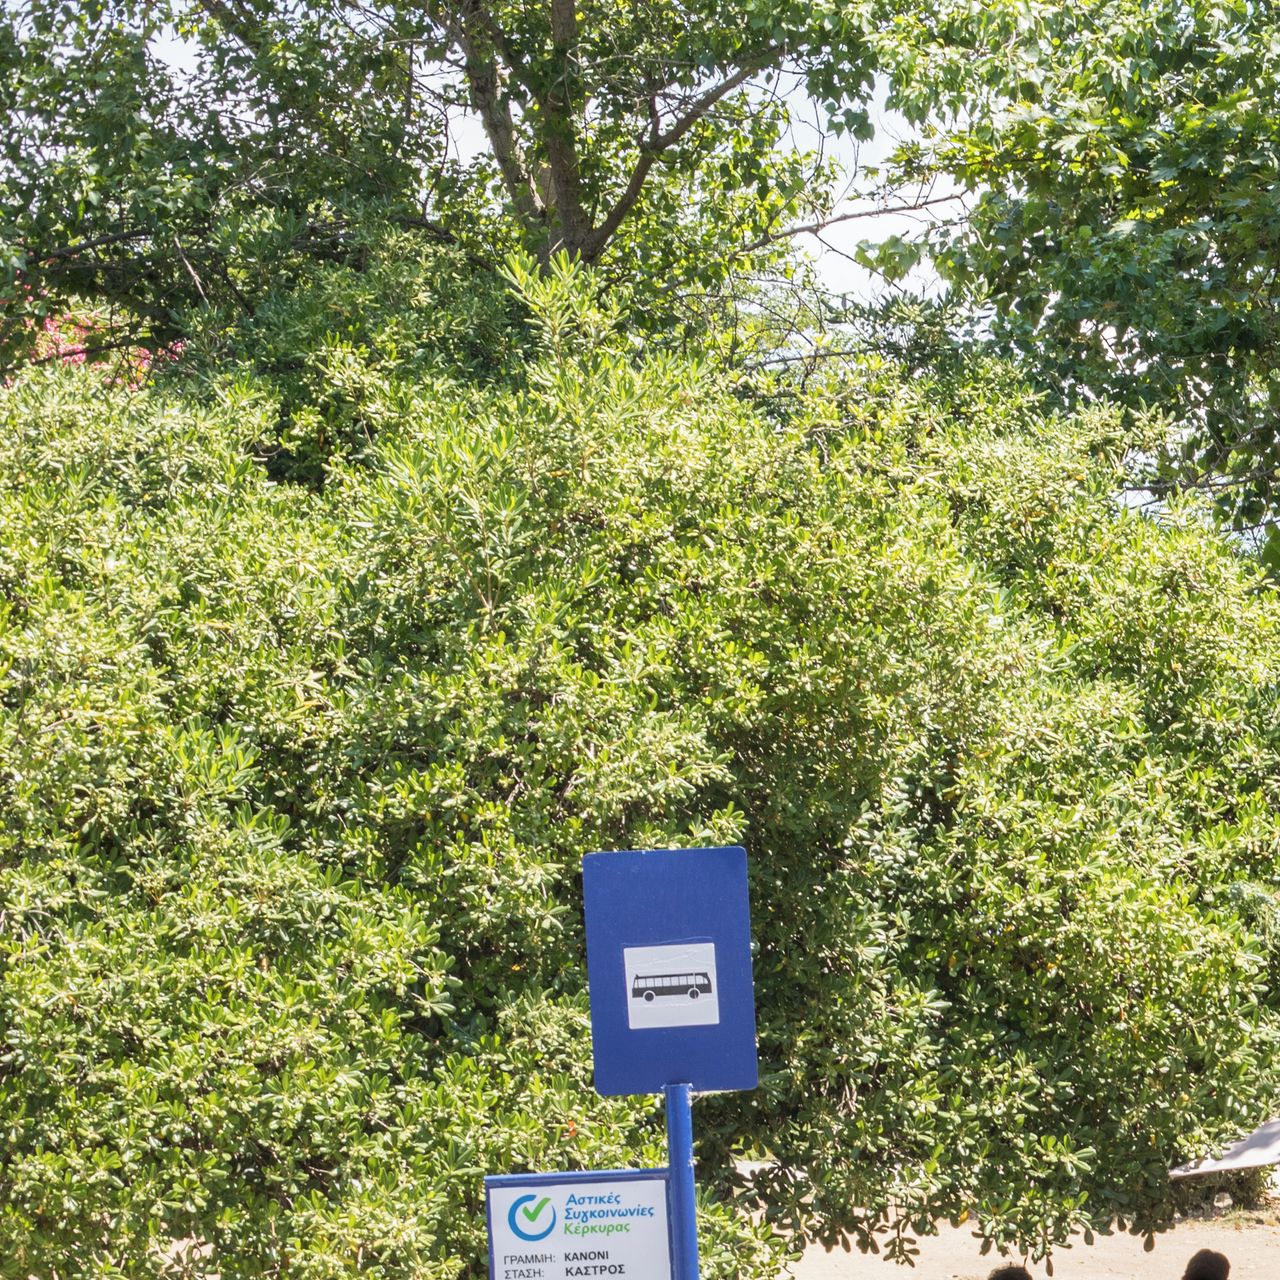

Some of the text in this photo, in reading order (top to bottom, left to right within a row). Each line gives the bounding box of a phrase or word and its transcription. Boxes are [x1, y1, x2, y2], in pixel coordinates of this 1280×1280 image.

[566, 1192, 620, 1205] Αστικές
[564, 1204, 654, 1223] Συγκοινωνίες
[563, 1222, 631, 1237] Κέρκυρας
[504, 1253, 556, 1265] ΓΡΑΜΜΗ:
[504, 1264, 625, 1279] ΣΤΑΣΗ: ΚΑΣΤΡΟΣ
